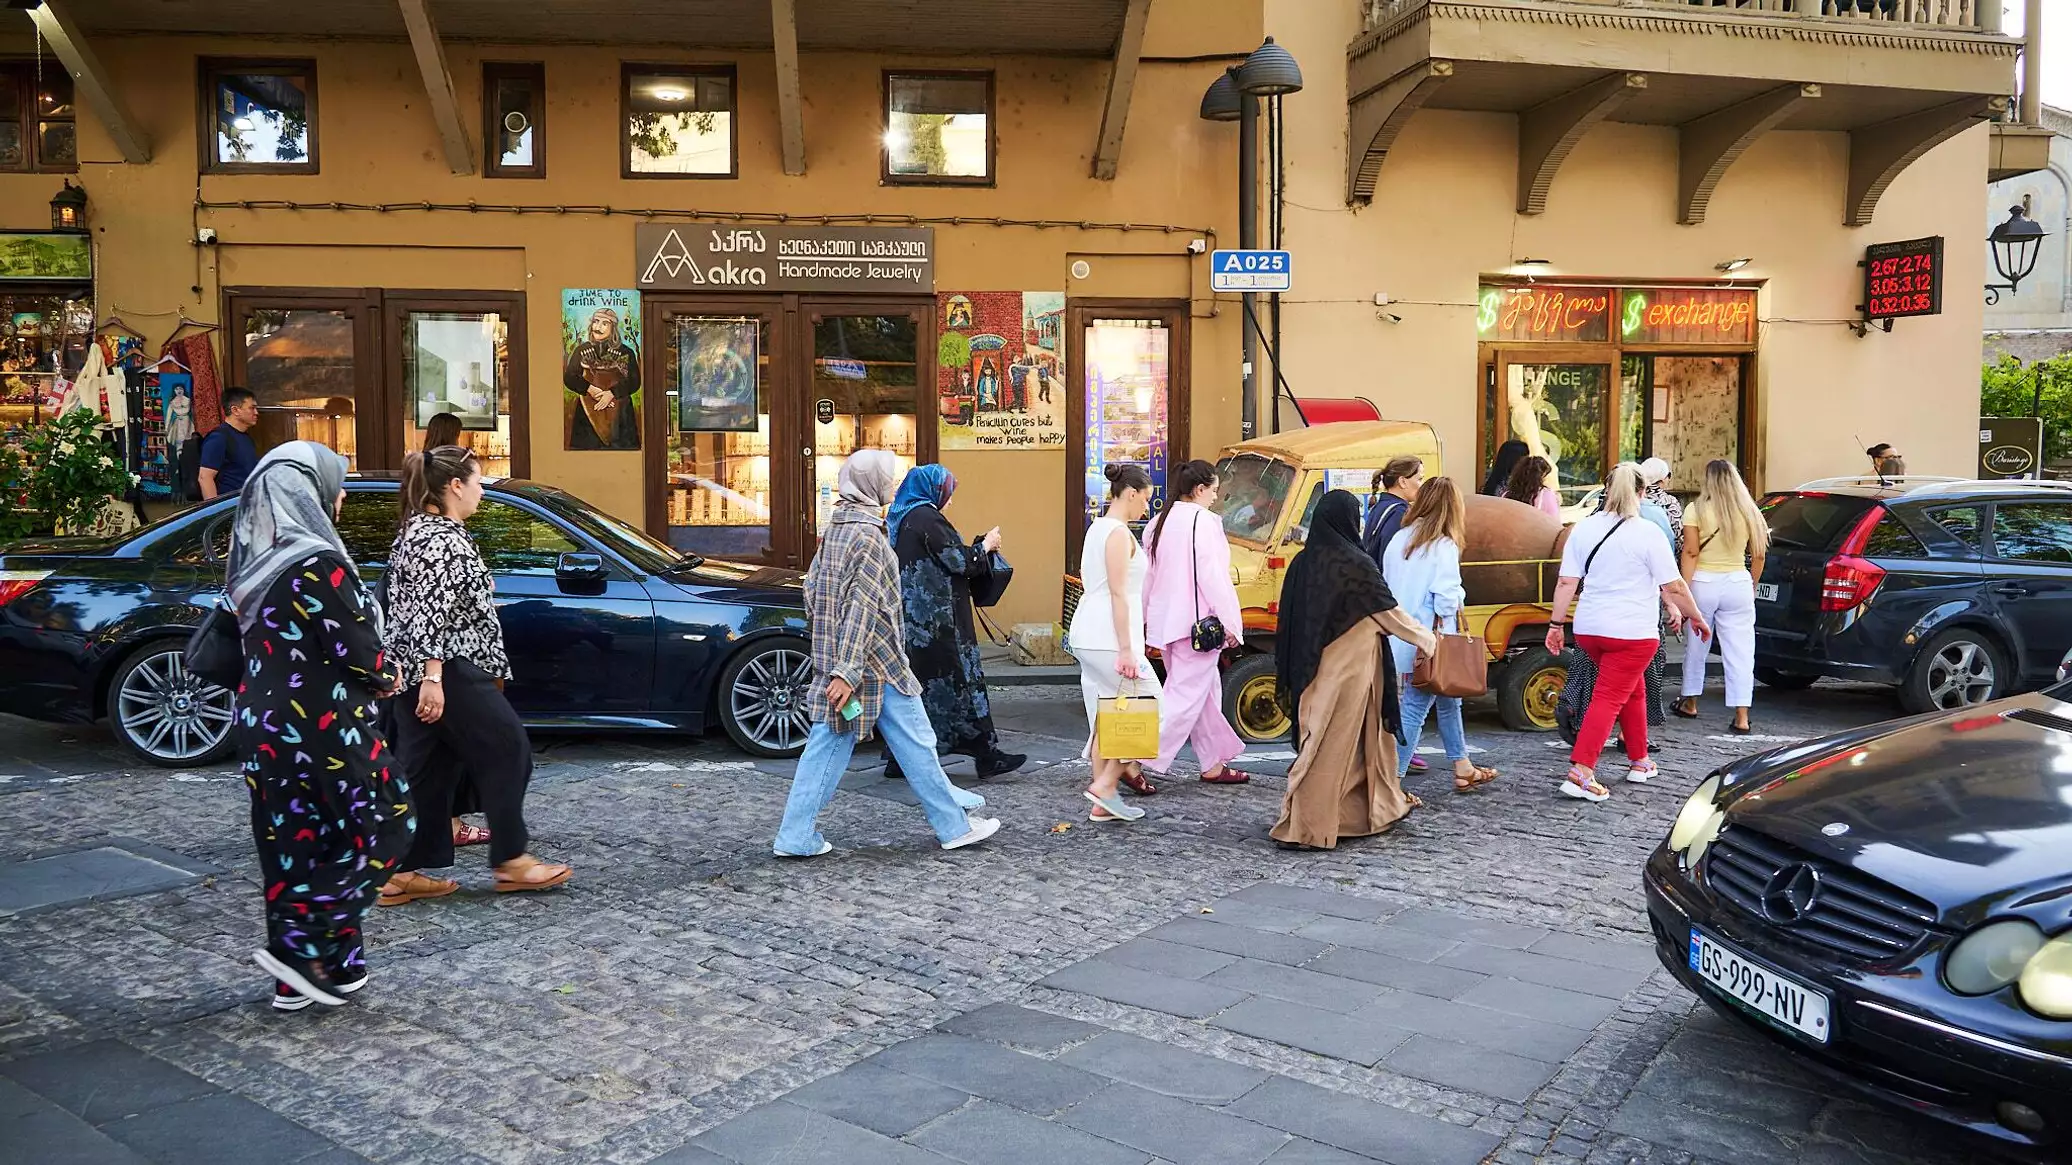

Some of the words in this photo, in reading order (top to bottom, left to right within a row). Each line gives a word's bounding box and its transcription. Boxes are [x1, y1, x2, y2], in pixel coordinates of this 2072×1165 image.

[709, 230, 766, 252] აკრა
[778, 239, 857, 256] ხელნაკეთი
[861, 240, 927, 257] სამკაული
[708, 259, 766, 286] akra
[778, 262, 861, 280] Handmade
[865, 263, 922, 283] Jewelry
[1648, 297, 1750, 332] exchange
[1038, 414, 1053, 427] but
[976, 436, 1003, 445] makes
[1006, 436, 1035, 446] people
[1702, 941, 1806, 1026] GS-999-NV
